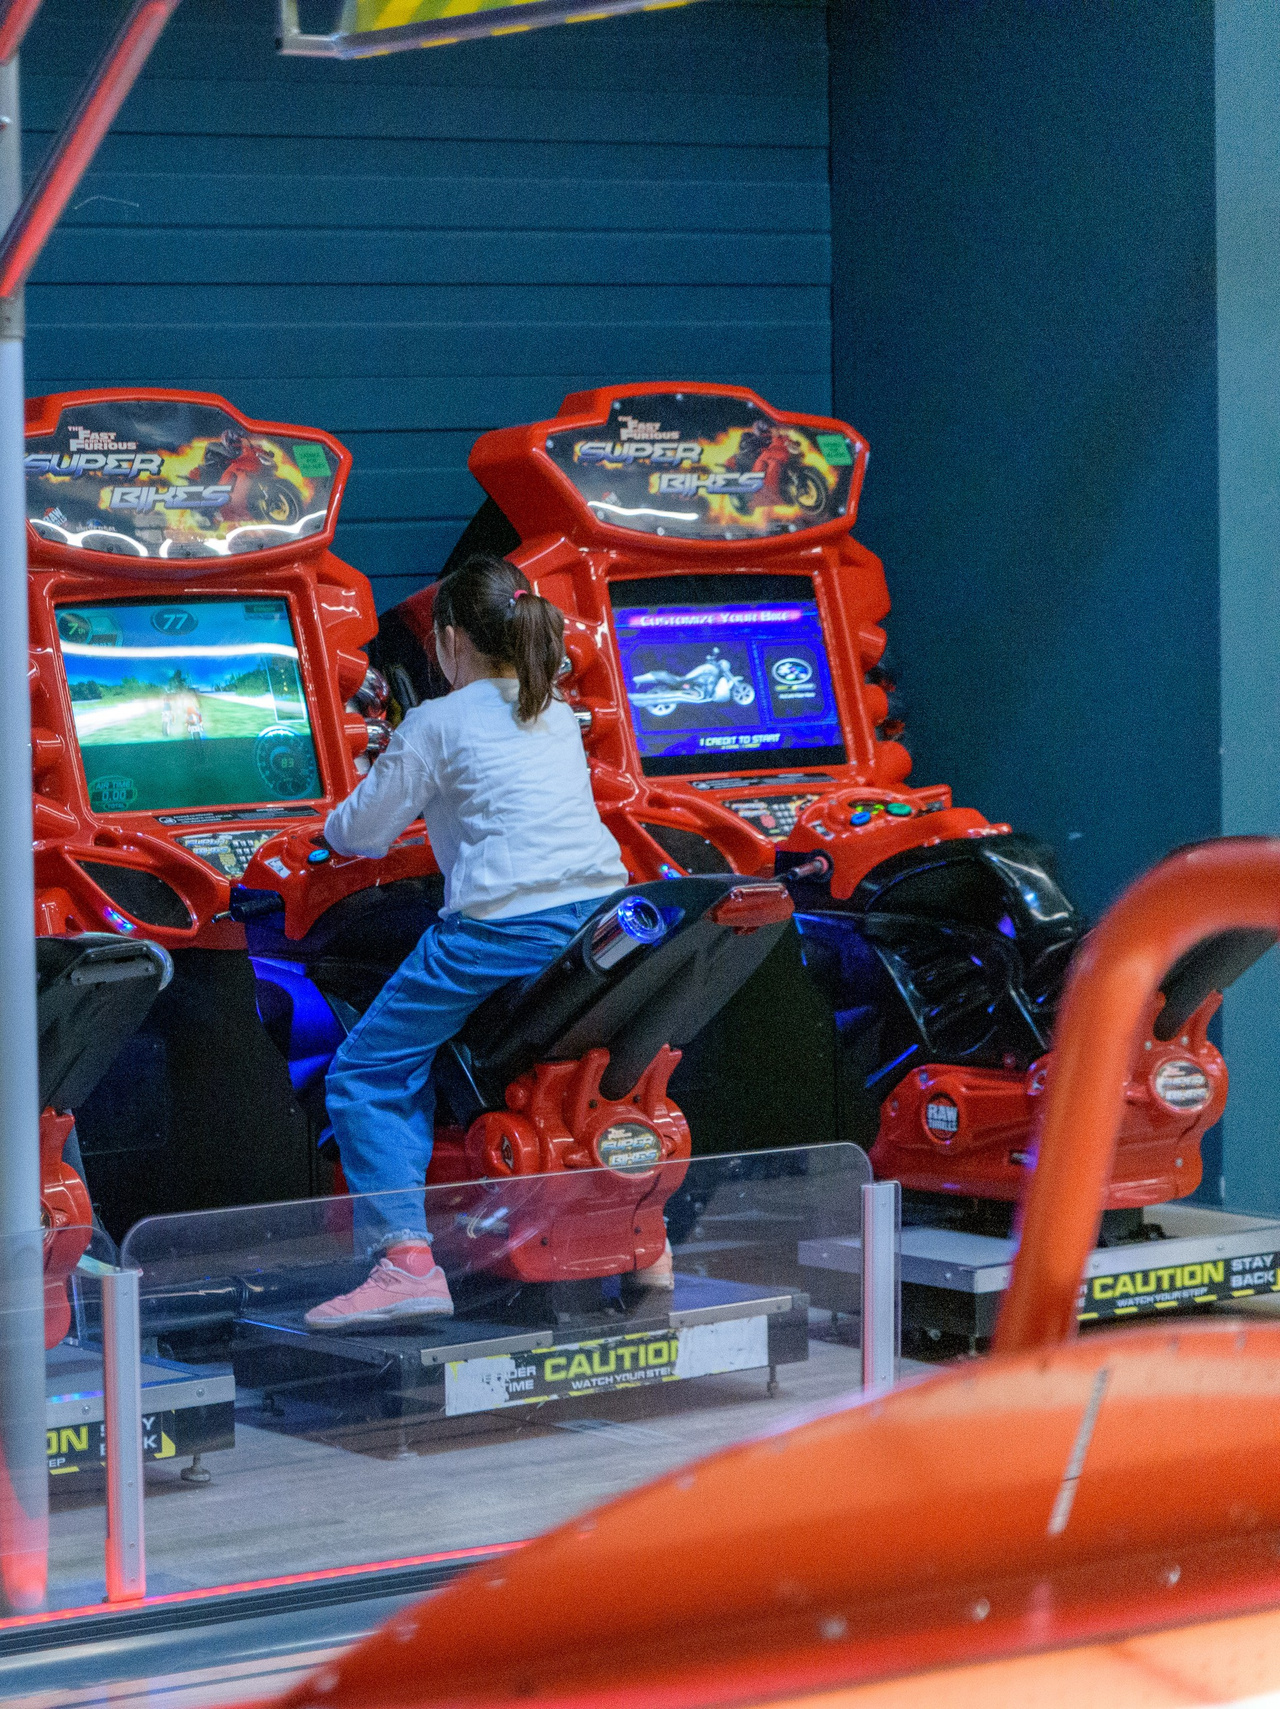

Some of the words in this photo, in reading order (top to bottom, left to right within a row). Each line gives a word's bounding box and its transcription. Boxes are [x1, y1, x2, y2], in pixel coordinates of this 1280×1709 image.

[78, 430, 116, 441] FAST
[620, 428, 680, 441] FURIOUS
[70, 439, 137, 451] FURIOUS
[576, 441, 704, 465] SUPER
[23, 453, 164, 479] SUPER
[659, 471, 766, 496] BIKES
[108, 485, 233, 512] BIKES
[162, 611, 188, 631] 77
[927, 1104, 958, 1121] RAW
[1231, 1254, 1275, 1272] STAY
[1093, 1260, 1226, 1300] CAUTION
[1231, 1270, 1276, 1288] BACK
[572, 1375, 614, 1390] WATCH
[614, 1370, 645, 1382] YOUR
